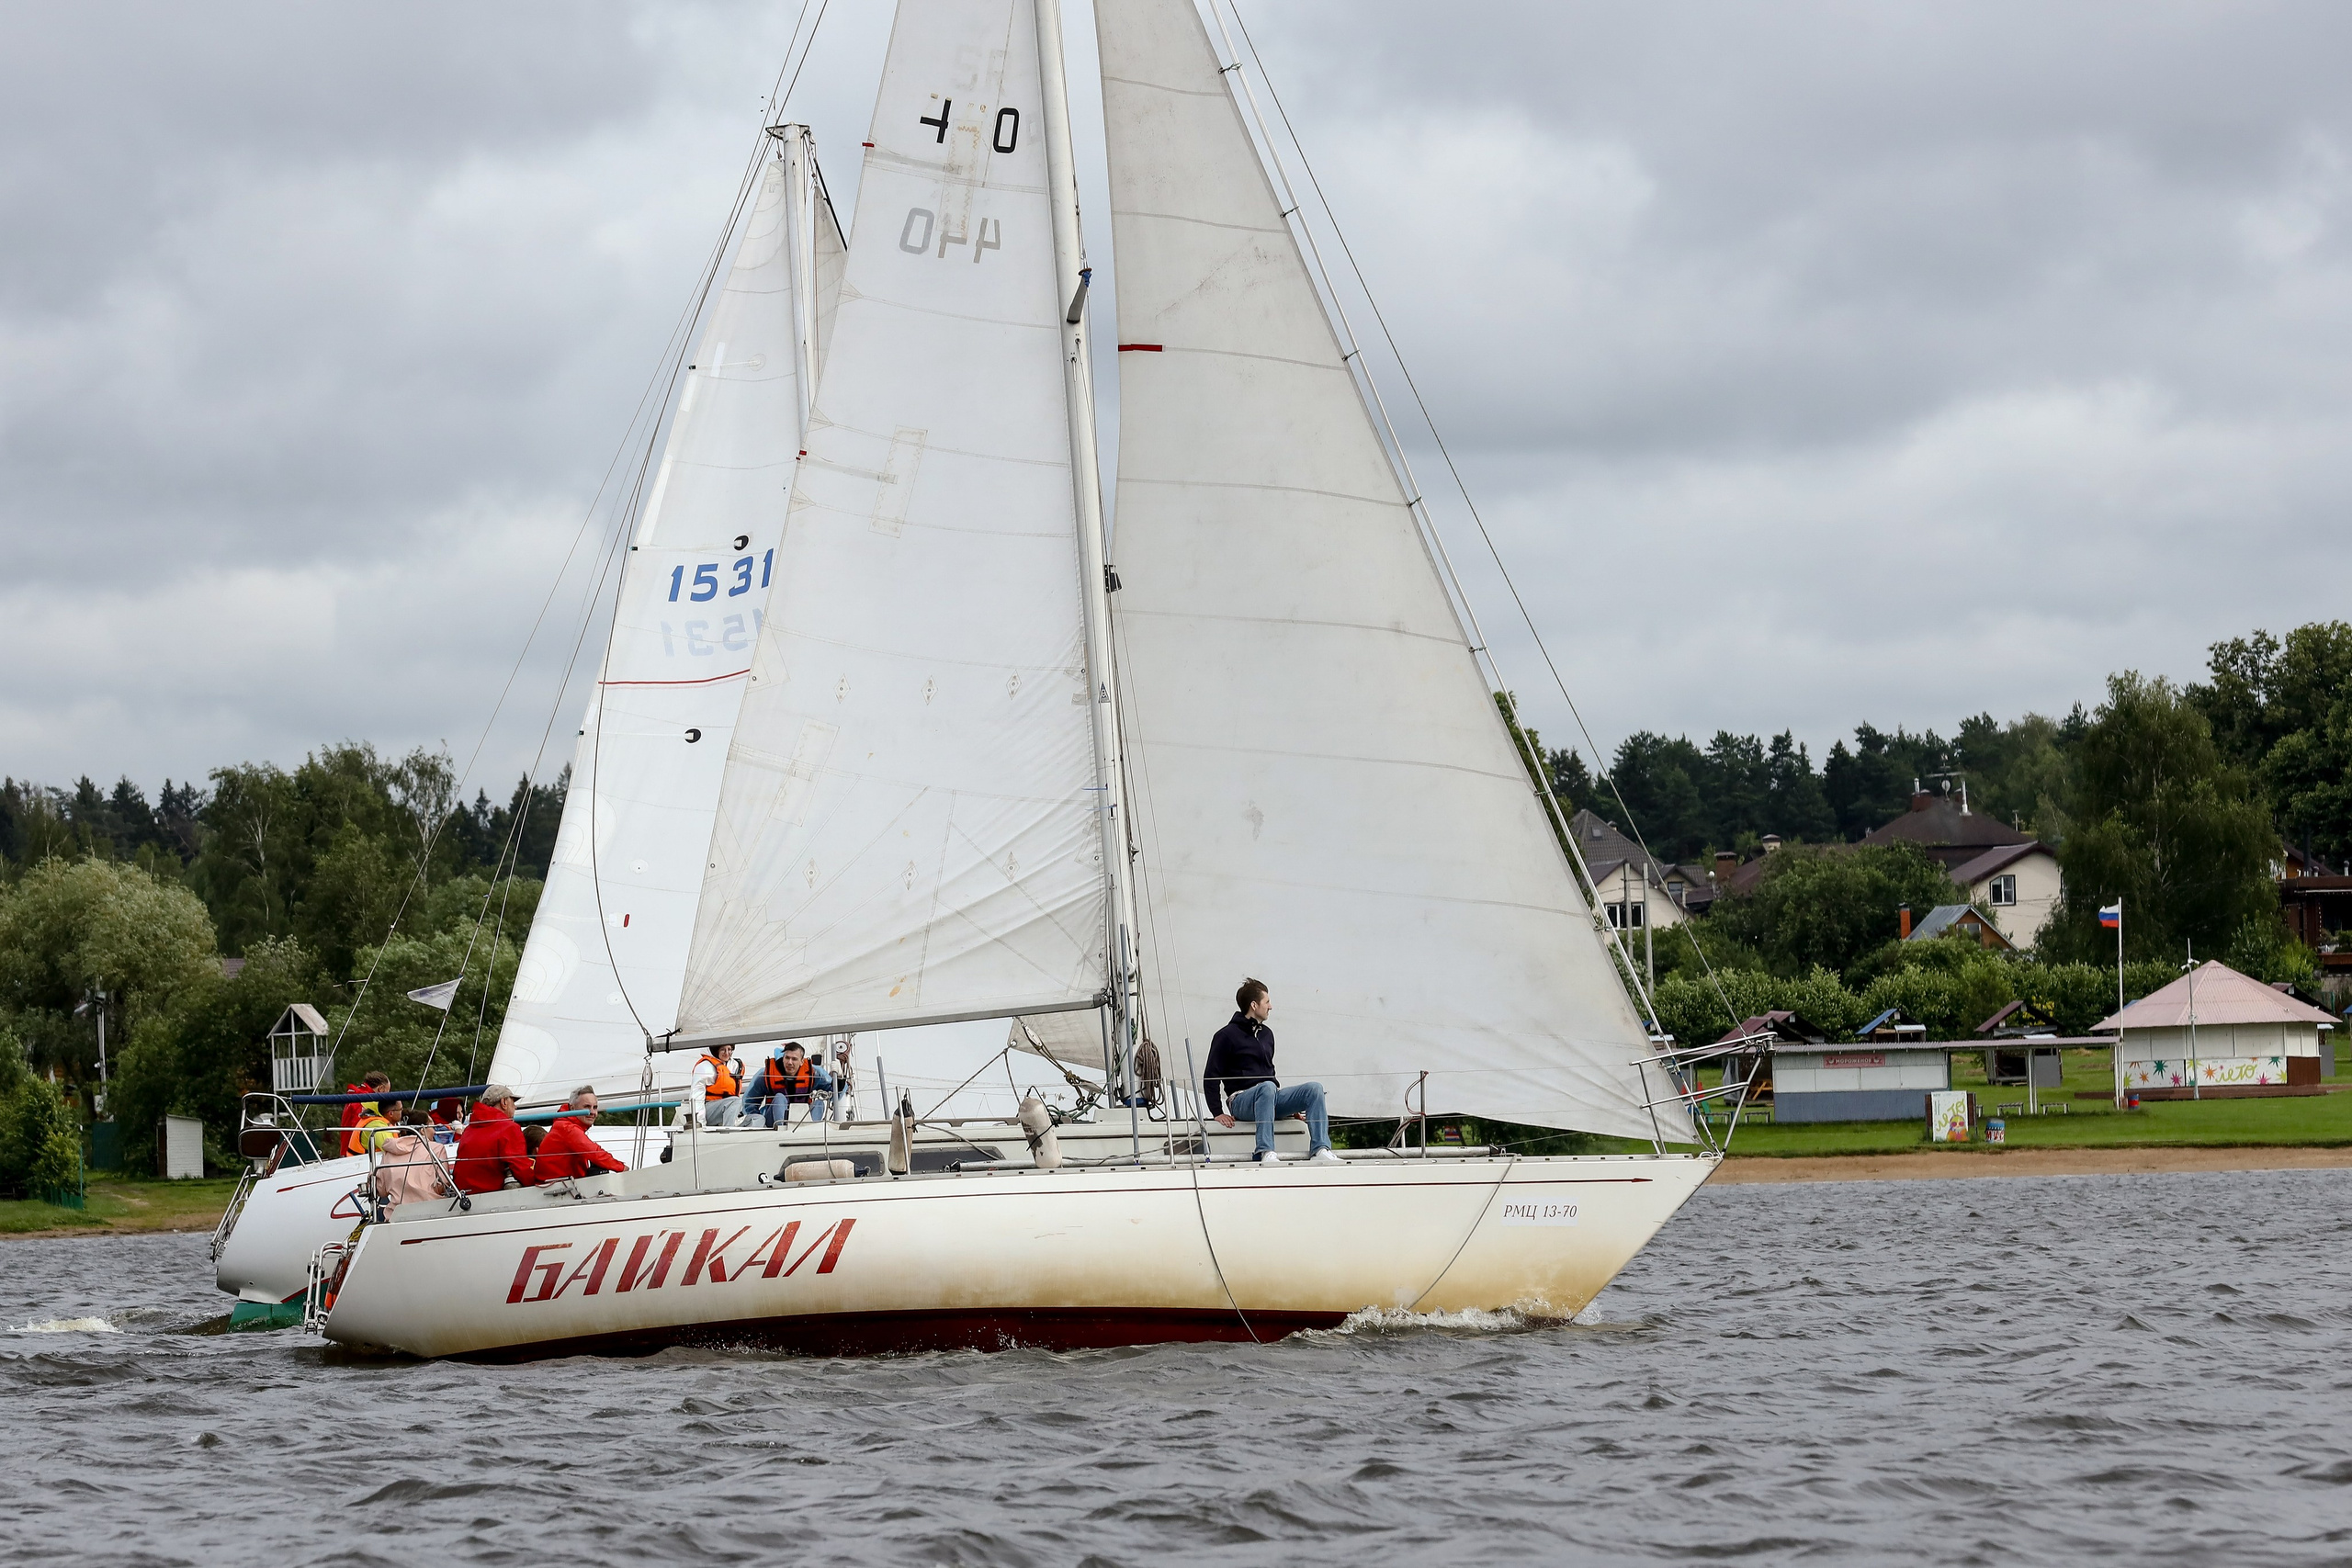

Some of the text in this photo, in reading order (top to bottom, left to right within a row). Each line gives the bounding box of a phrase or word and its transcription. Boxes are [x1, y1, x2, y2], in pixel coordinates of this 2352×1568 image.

[668, 548, 774, 602] 1531
[1503, 1204, 1577, 1220] РМЦ 13-70
[505, 1218, 858, 1303] БАЙКАЛ
